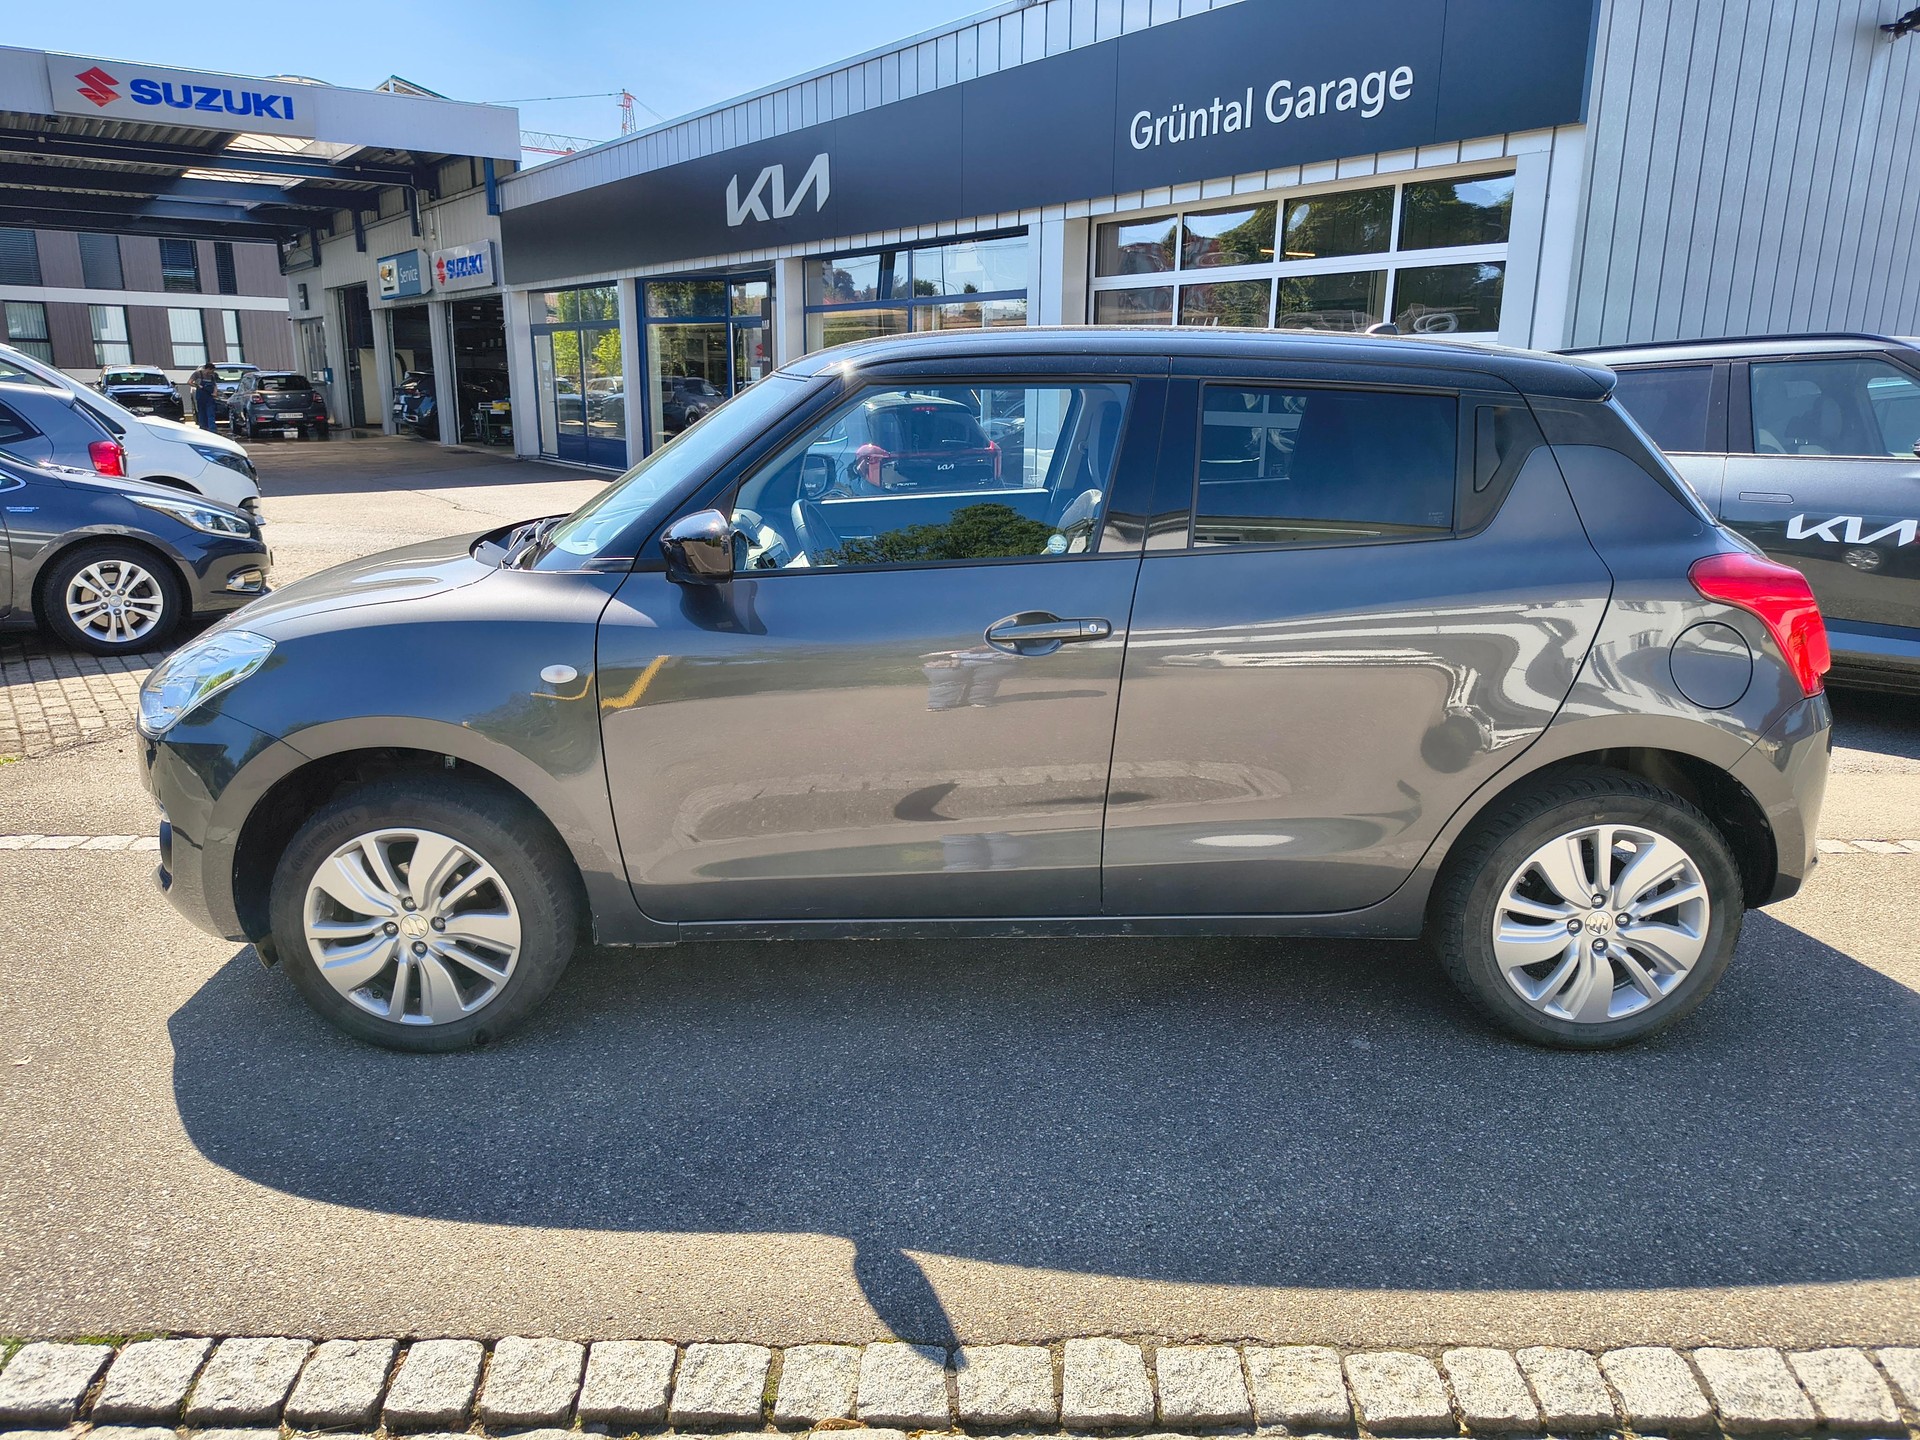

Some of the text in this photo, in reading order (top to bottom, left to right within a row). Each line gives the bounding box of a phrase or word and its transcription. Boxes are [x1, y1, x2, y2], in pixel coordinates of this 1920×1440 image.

[129, 78, 295, 120] SUZUKI
[1130, 65, 1414, 150] Grüntal Garage
[726, 152, 830, 227] KIA
[400, 265, 418, 283] Service
[1786, 513, 1918, 547] KIA
